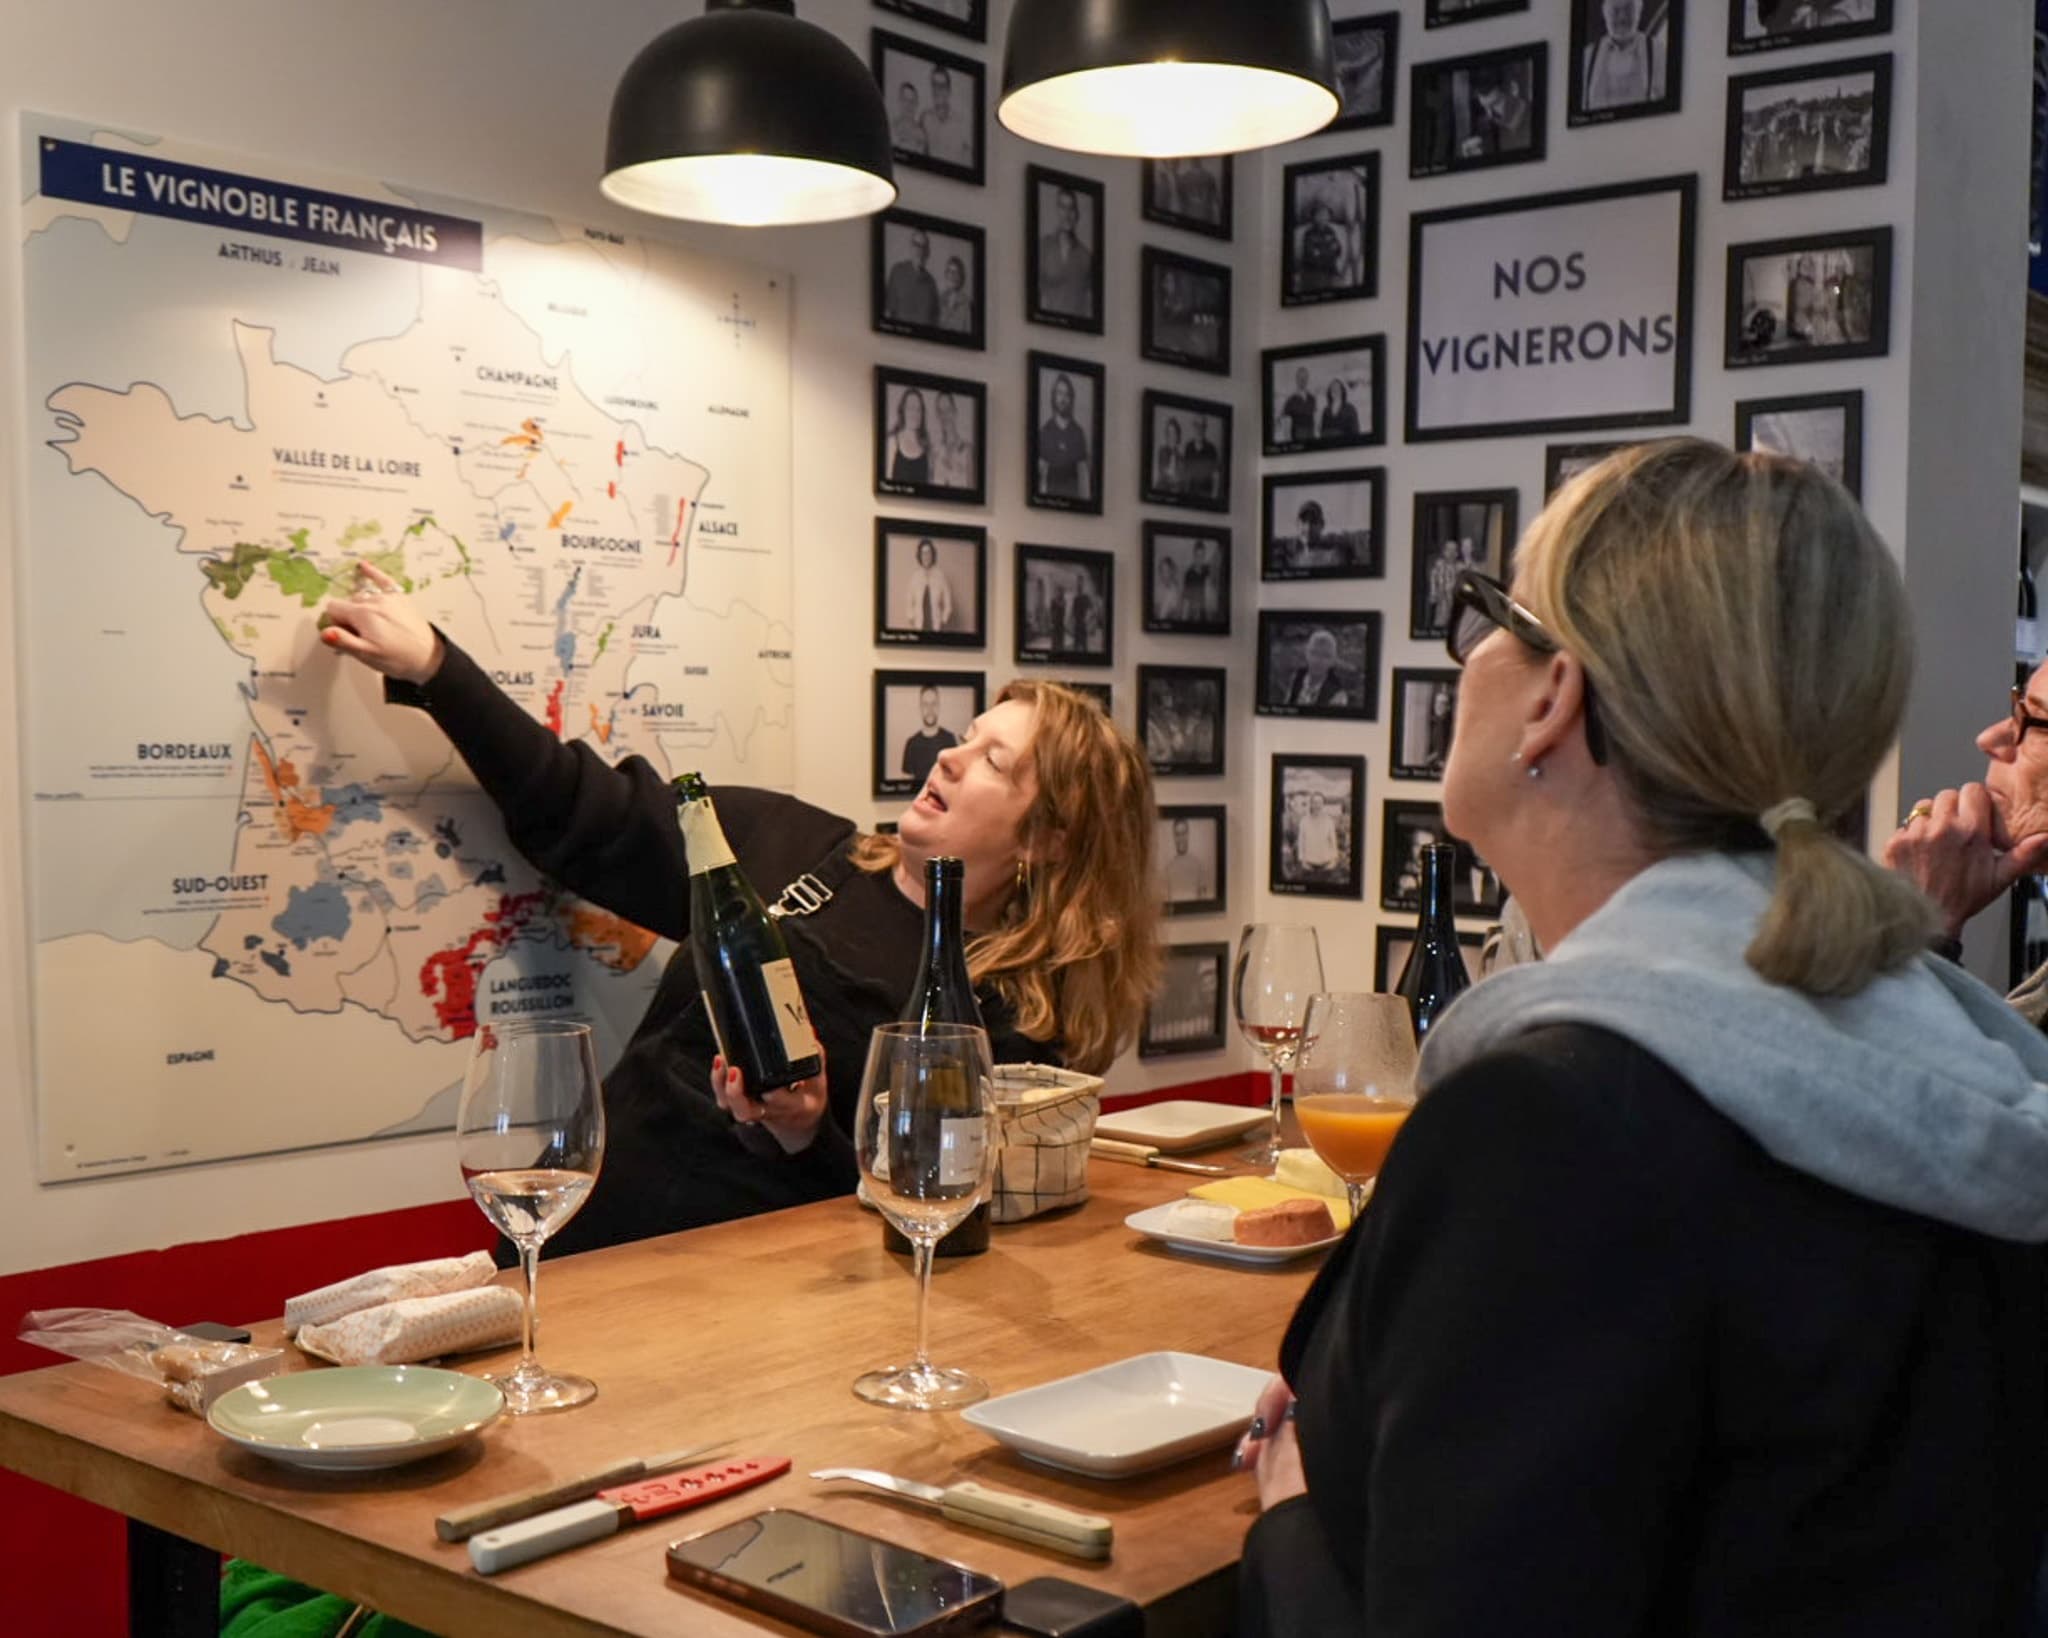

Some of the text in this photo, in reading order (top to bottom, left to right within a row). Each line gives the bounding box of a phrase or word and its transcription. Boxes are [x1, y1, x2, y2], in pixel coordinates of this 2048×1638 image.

[102, 163, 438, 253] LE VIGNOBLE FRANÇAIS
[218, 243, 340, 277] ARTHUS JEAN
[1493, 252, 1586, 299] NOS
[1421, 314, 1674, 375] VIGNERONS
[476, 366, 558, 391] CHAMPAGNE
[272, 448, 421, 477] VALLÉE DE LA LOIRE
[698, 521, 738, 536] ALSACE
[561, 533, 641, 554] BOURGOGNE
[631, 625, 661, 640] JURA
[642, 703, 684, 718] SAVOIE
[137, 743, 232, 760] BORDEAUX
[172, 874, 268, 895] SUD-OUEST
[490, 973, 572, 995] LANGUEDOC
[490, 995, 574, 1015] ROUSSILLON
